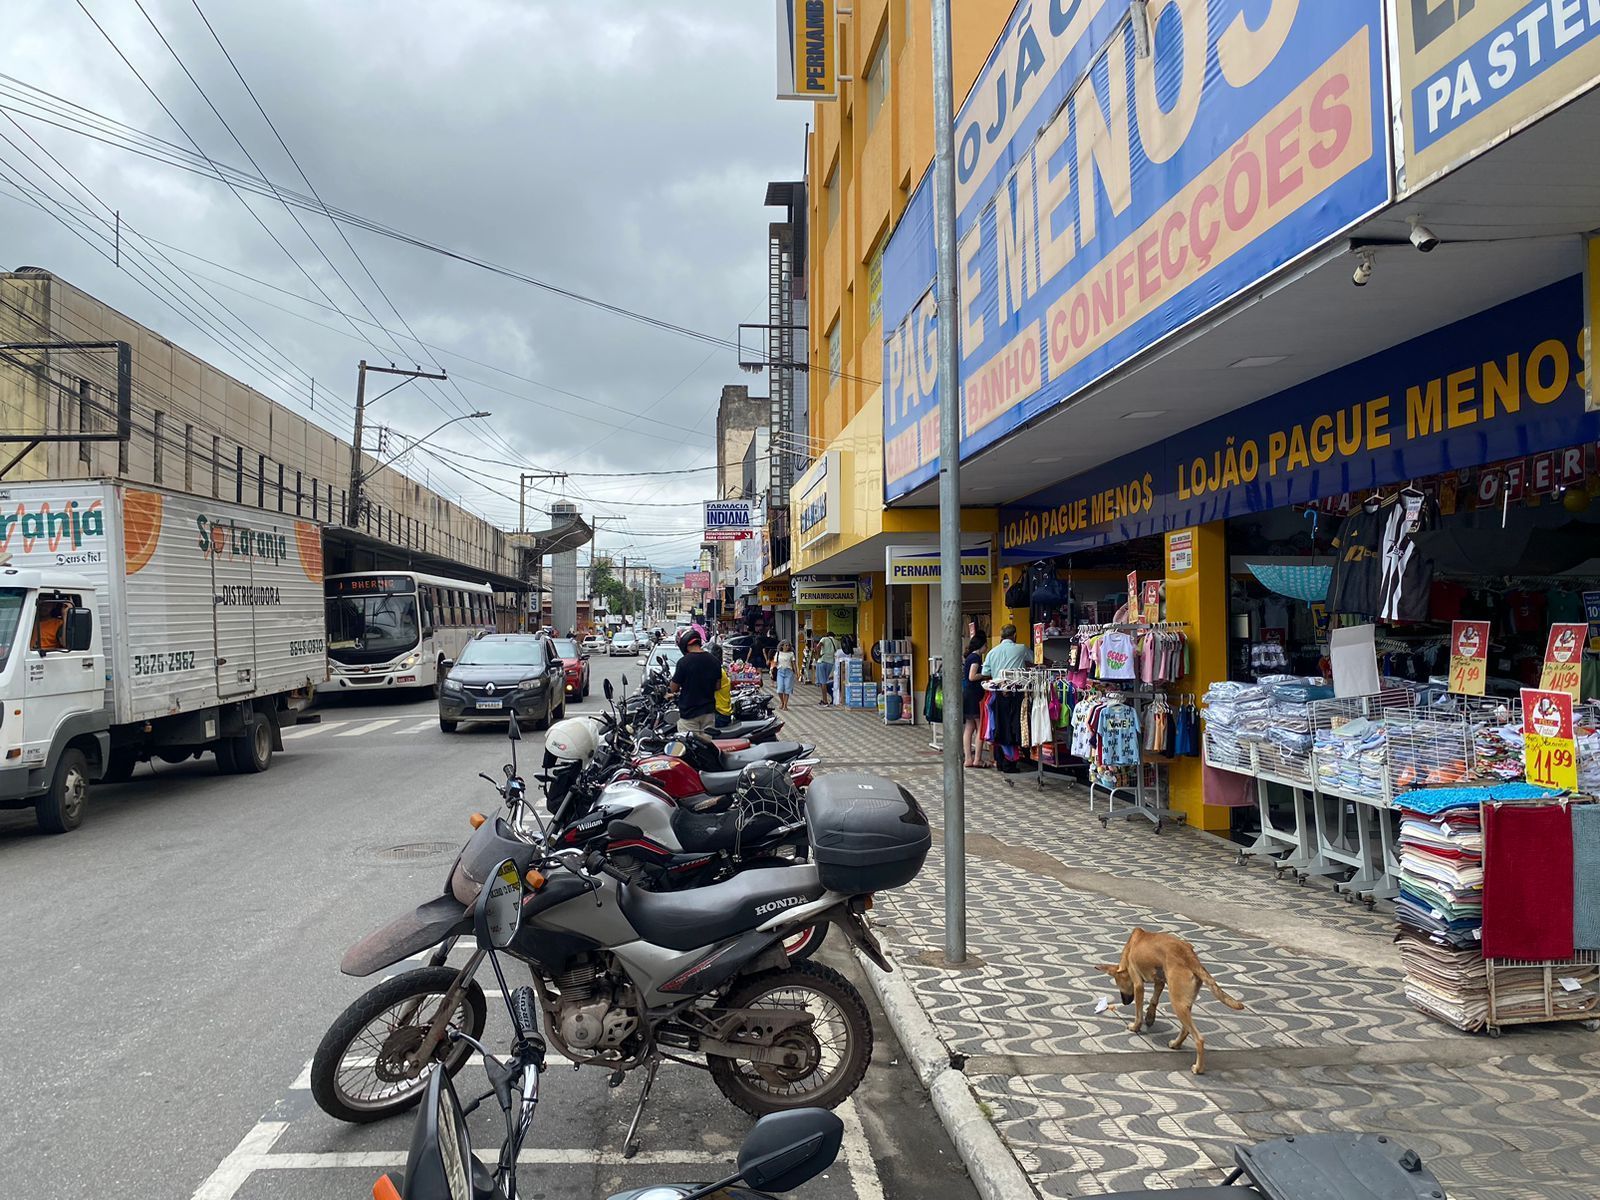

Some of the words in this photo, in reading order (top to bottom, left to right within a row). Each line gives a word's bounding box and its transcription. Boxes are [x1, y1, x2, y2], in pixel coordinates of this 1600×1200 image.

[966, 337, 1037, 428] BANHO
[1051, 73, 1353, 365] CONFECÇÕES
[1178, 436, 1259, 501] LOJÃO
[1268, 396, 1391, 476] PAGUE
[706, 511, 750, 524] INDIANA
[1004, 511, 1038, 549] LOJÃO
[1041, 498, 1088, 539] PAGUE
[231, 519, 287, 566] Laranja
[222, 585, 281, 606] DISTRIBUIDORA
[800, 592, 855, 600] PERNAMBUCANAS
[754, 895, 809, 916] HONDA
